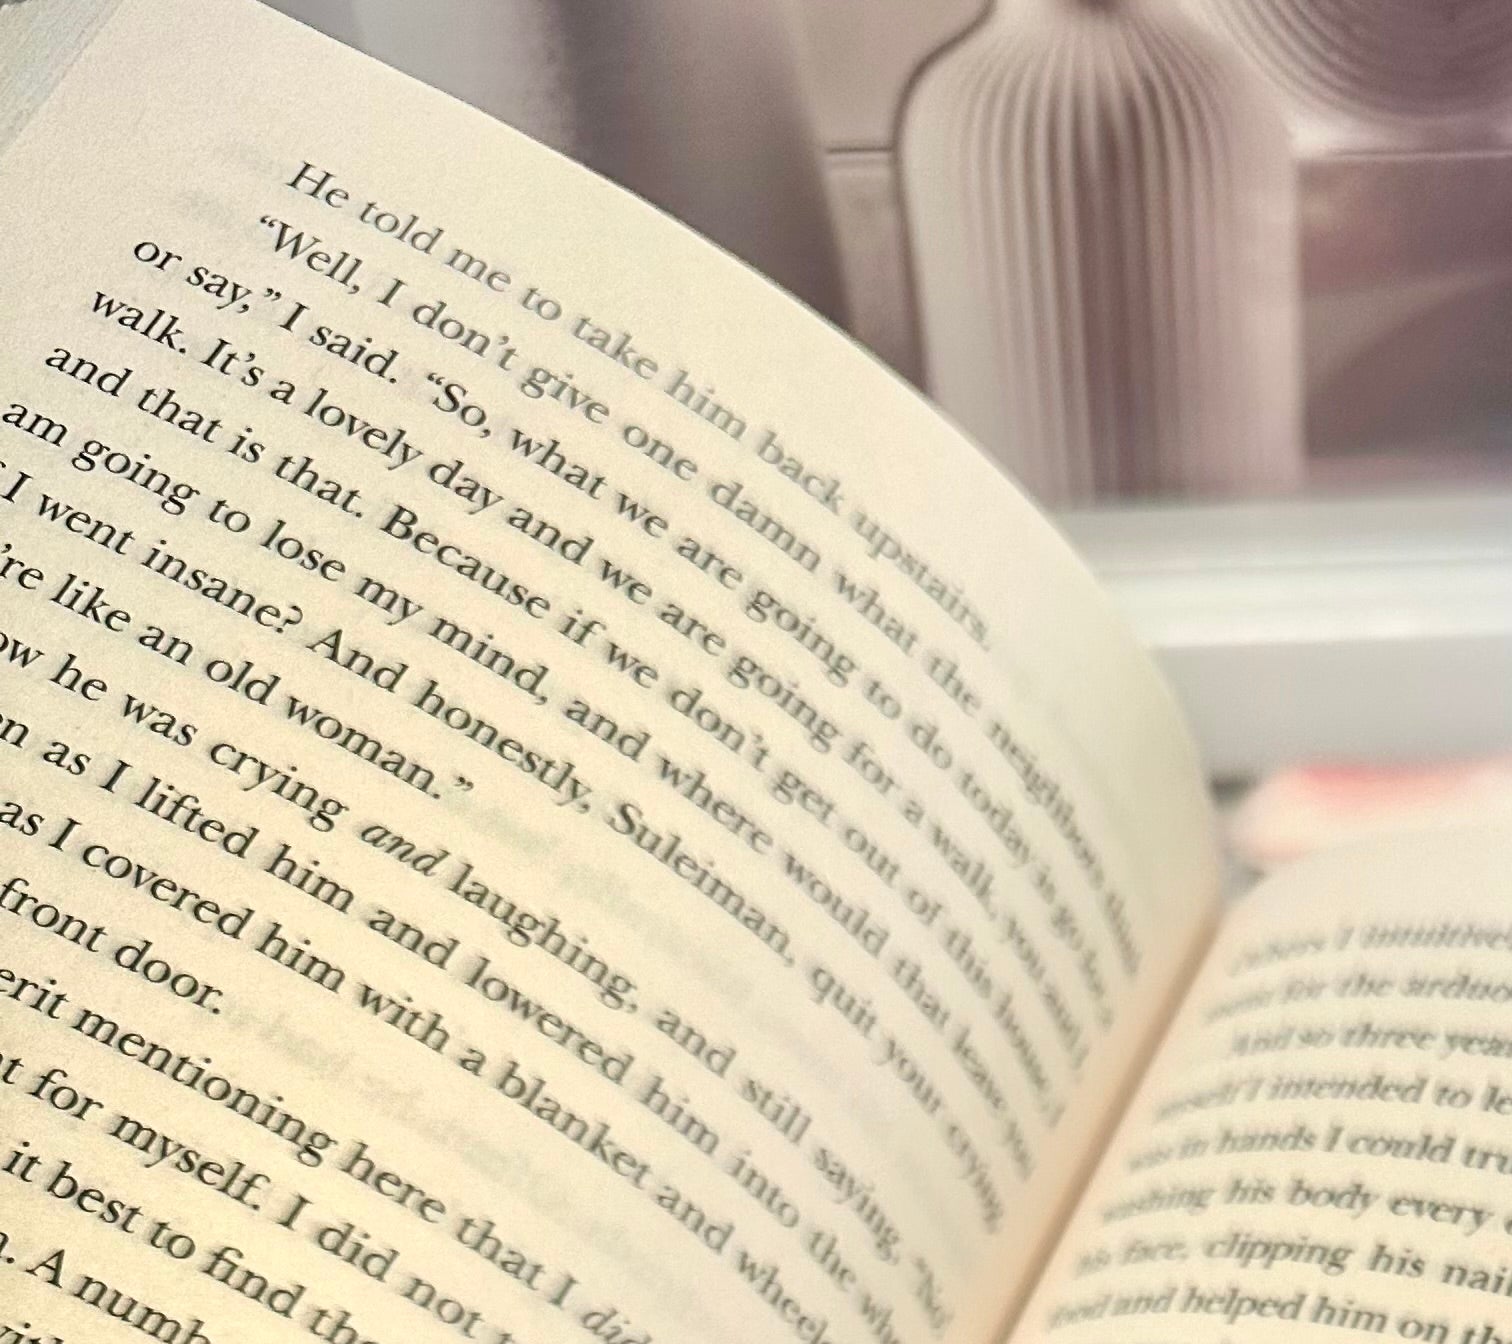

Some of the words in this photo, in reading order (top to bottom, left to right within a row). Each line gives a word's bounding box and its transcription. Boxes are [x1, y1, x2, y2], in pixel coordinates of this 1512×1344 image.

[287, 162, 349, 207] He
[360, 203, 444, 254] told
[446, 249, 510, 291] me
[521, 288, 561, 320] to
[93, 292, 185, 353] walk.
[201, 339, 264, 386] It’s
[270, 381, 295, 404] a
[304, 388, 423, 465] lovely
[429, 460, 503, 509] day
[507, 508, 594, 565] and
[602, 560, 652, 604] we
[659, 603, 725, 654] are
[3, 471, 30, 503] I
[39, 494, 134, 554] went
[141, 540, 302, 633] insane?
[306, 629, 408, 692] And
[413, 680, 591, 813] honestly,
[50, 574, 130, 631] like
[138, 626, 193, 665] an
[205, 660, 280, 705] old
[288, 696, 473, 799] woman.”
[0, 878, 106, 952] front
[114, 940, 223, 1014] door.
[42, 742, 90, 775] as
[100, 760, 130, 793] I
[134, 777, 259, 858] lifted
[264, 844, 354, 913] him
[367, 910, 459, 969] and
[465, 957, 634, 1085] lowered
[46, 1161, 141, 1233] best
[149, 1222, 195, 1259] to
[202, 1247, 306, 1318] find
